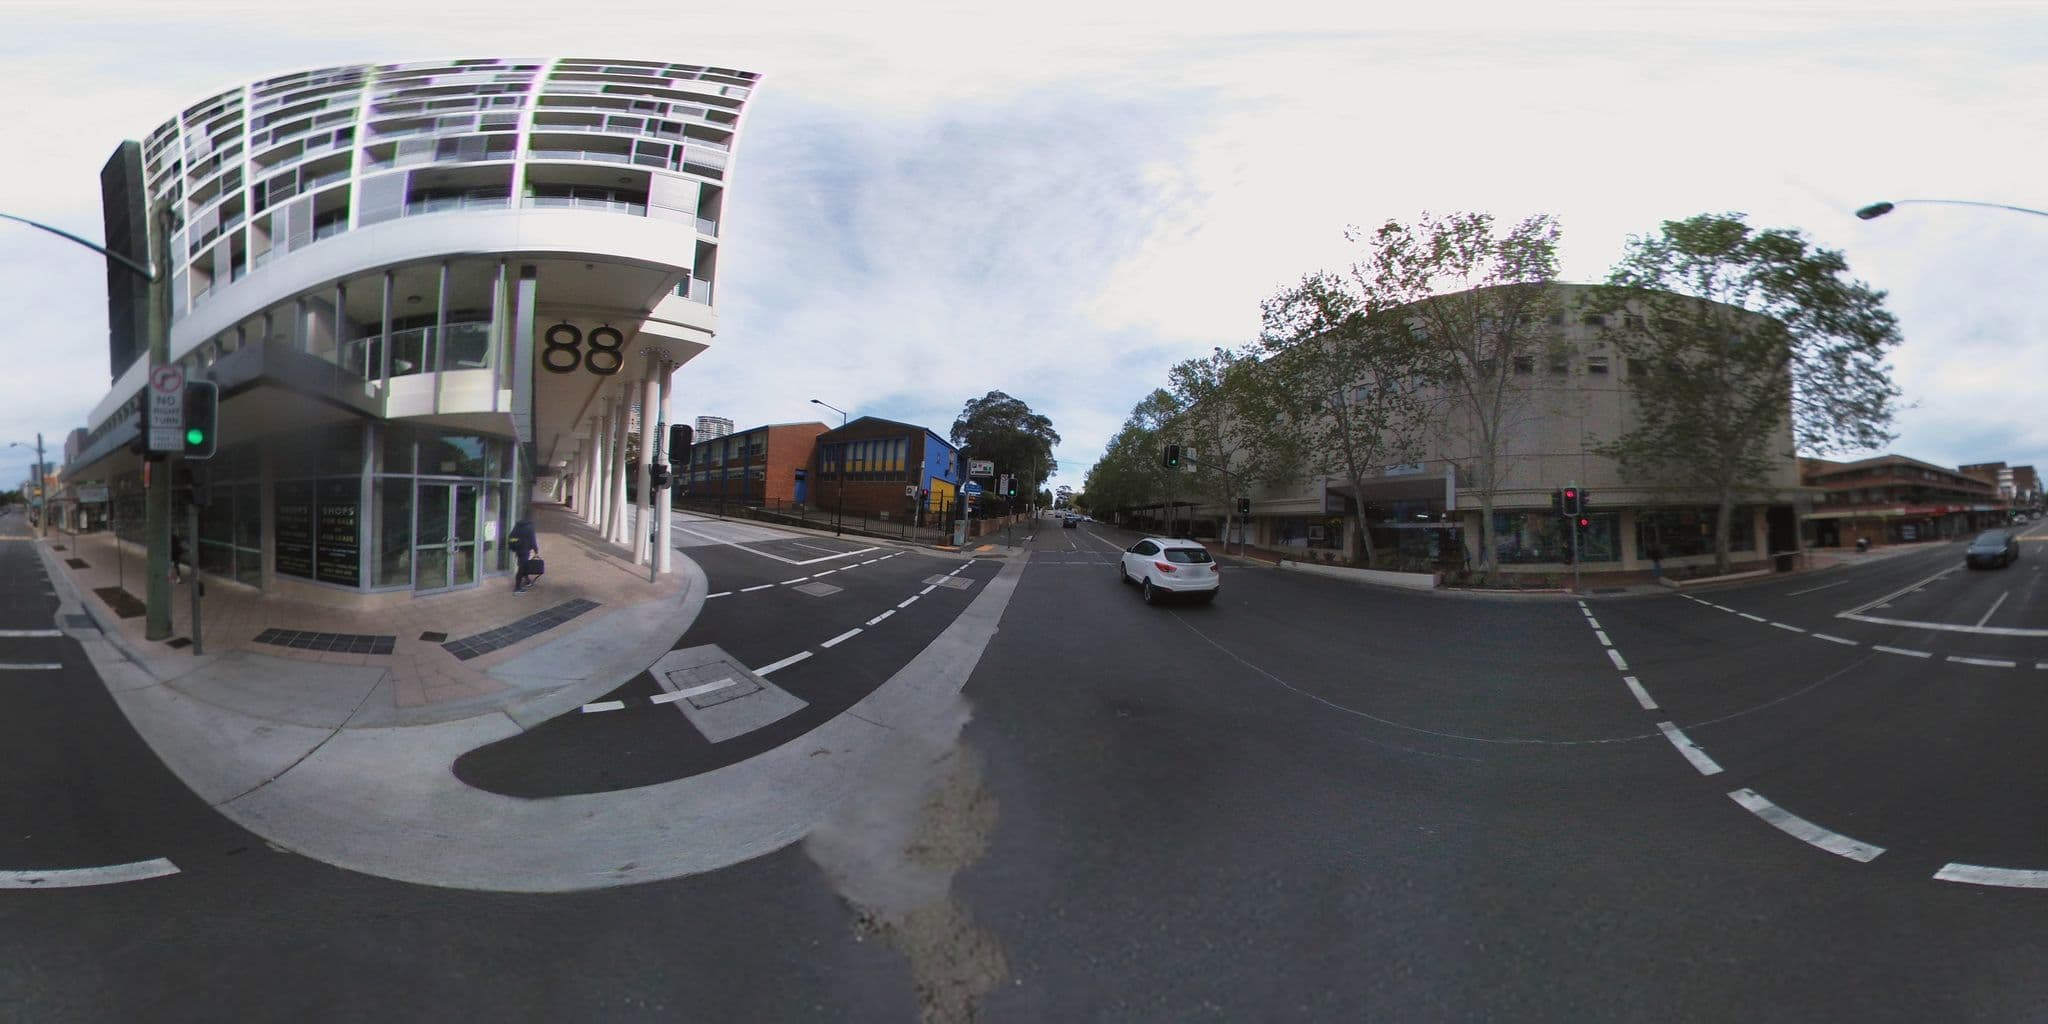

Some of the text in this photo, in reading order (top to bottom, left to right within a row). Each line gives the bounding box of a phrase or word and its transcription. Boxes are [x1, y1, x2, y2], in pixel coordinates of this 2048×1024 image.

[541, 322, 624, 376] 88
[156, 395, 176, 406] NO
[153, 407, 180, 415] RIGHT
[154, 416, 179, 424] TURN
[322, 506, 355, 516] SHOPS
[337, 518, 355, 526] SALE
